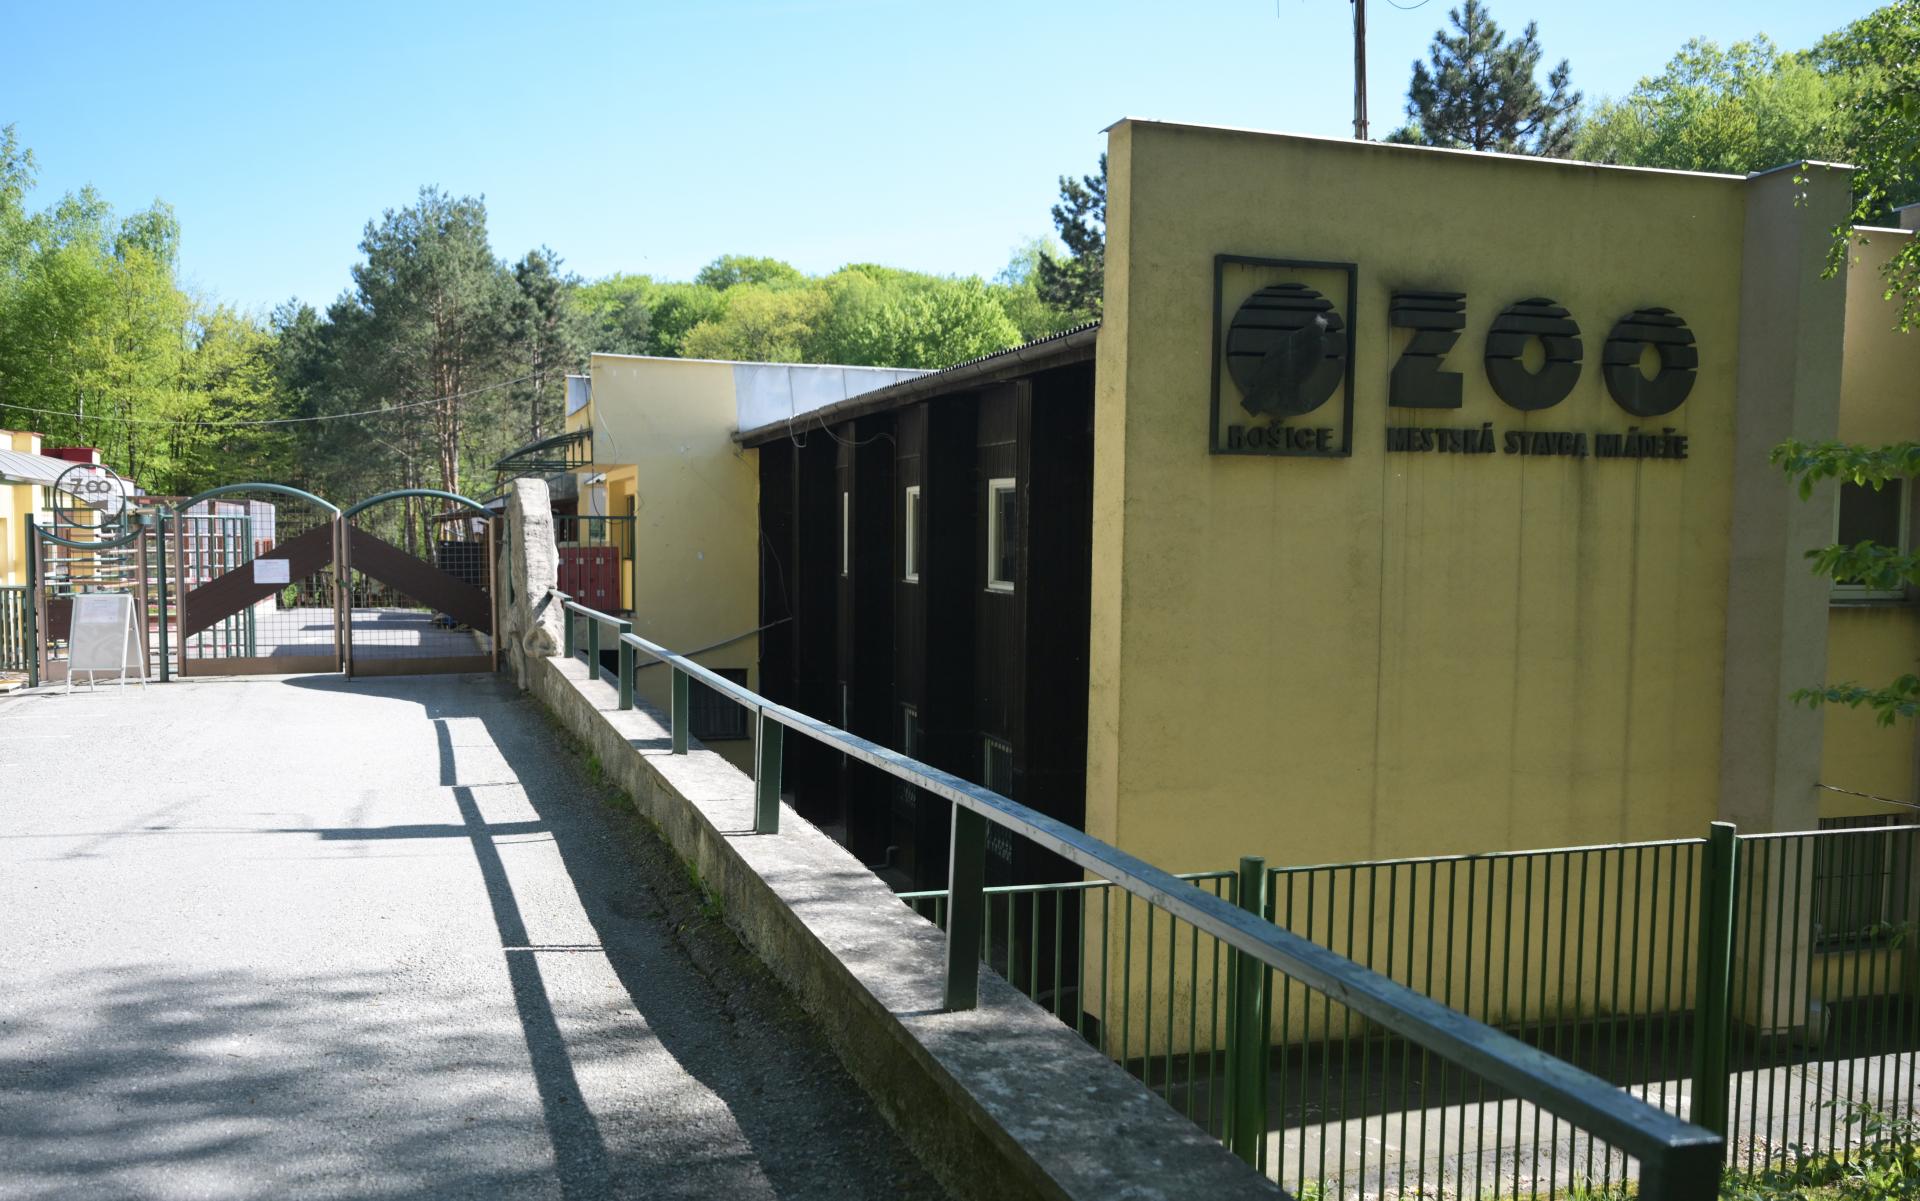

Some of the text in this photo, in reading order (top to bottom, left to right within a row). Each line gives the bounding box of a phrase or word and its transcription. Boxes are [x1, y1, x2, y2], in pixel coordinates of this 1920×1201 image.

[1389, 290, 1698, 417] ZOO
[1227, 419, 1334, 451] KOŠICE
[1386, 422, 1688, 459] MESTSKÁ STAVBA MLÁDEŽE
